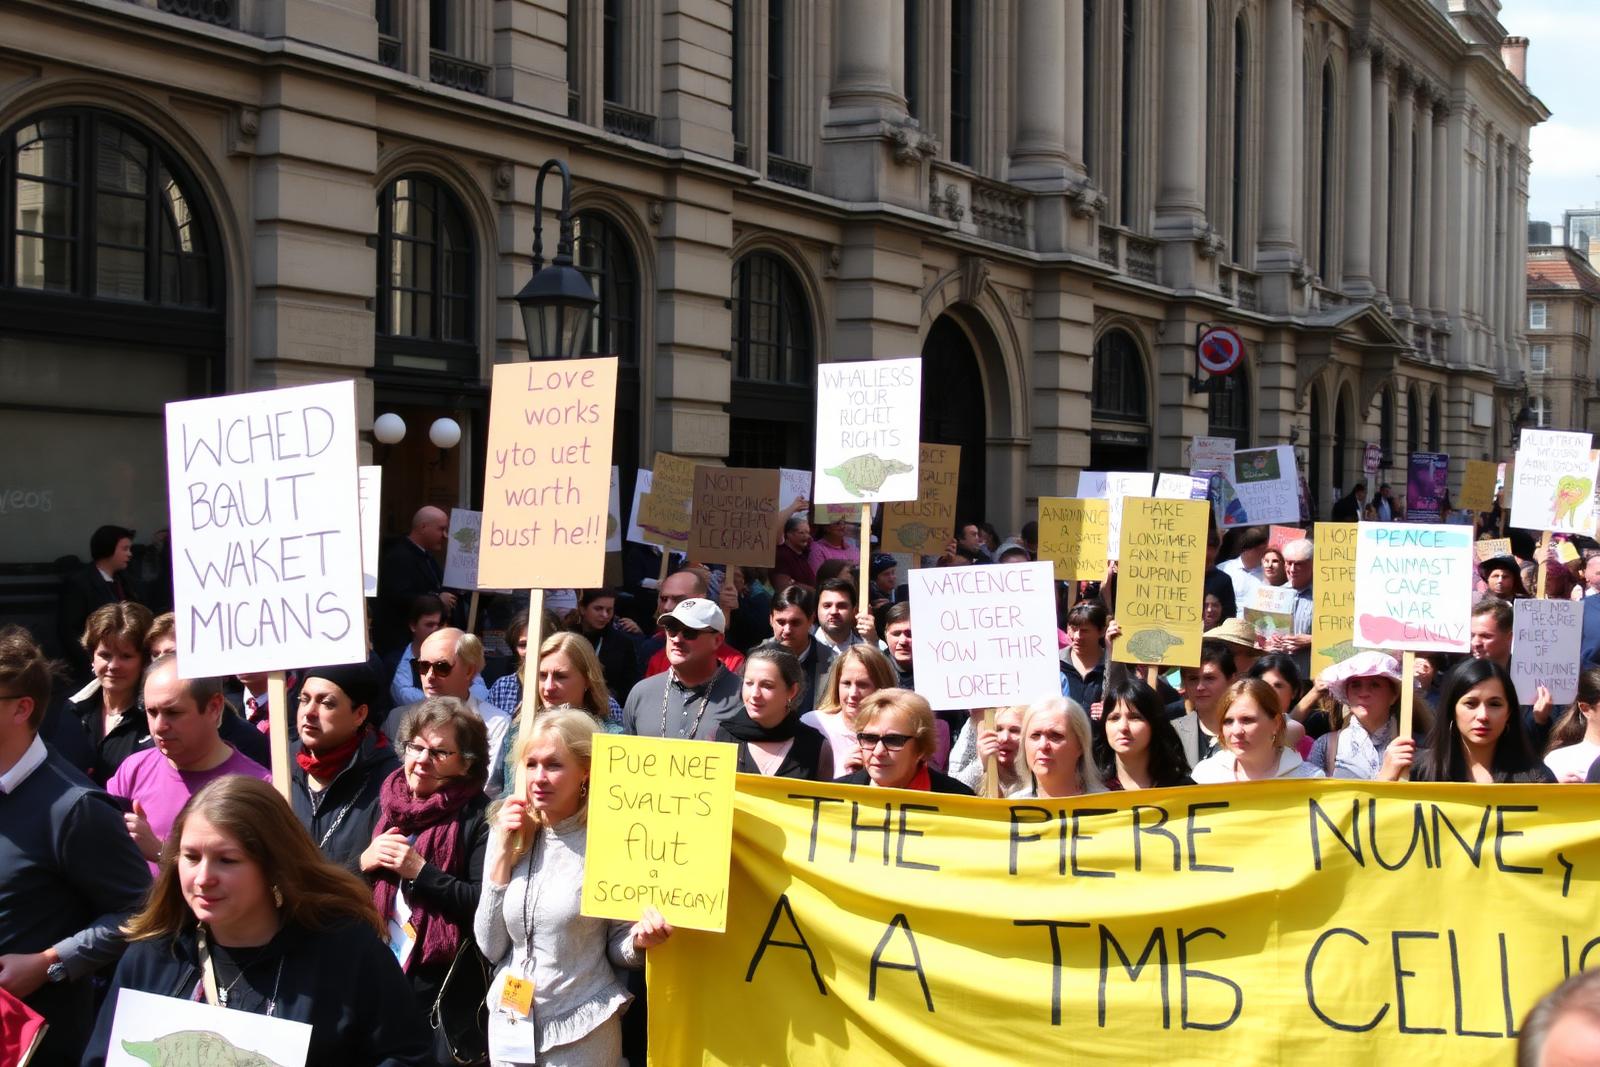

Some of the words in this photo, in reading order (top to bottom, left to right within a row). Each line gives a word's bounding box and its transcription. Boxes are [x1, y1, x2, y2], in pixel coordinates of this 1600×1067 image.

[528, 366, 595, 392] Love
[848, 389, 888, 406] YOUR
[525, 399, 600, 425] works
[182, 406, 335, 472] WCHED
[841, 428, 901, 449] RIGHTS
[505, 477, 580, 507] warth
[490, 520, 541, 546] bust
[553, 515, 600, 545] he!!
[1151, 518, 1175, 531] THE
[1376, 528, 1447, 548] PENCE
[184, 530, 341, 589] WAKET
[190, 591, 351, 653] MICANS
[988, 635, 1046, 660] THIR
[788, 793, 940, 871] THE
[745, 893, 828, 996] A
[868, 913, 935, 1013] A
